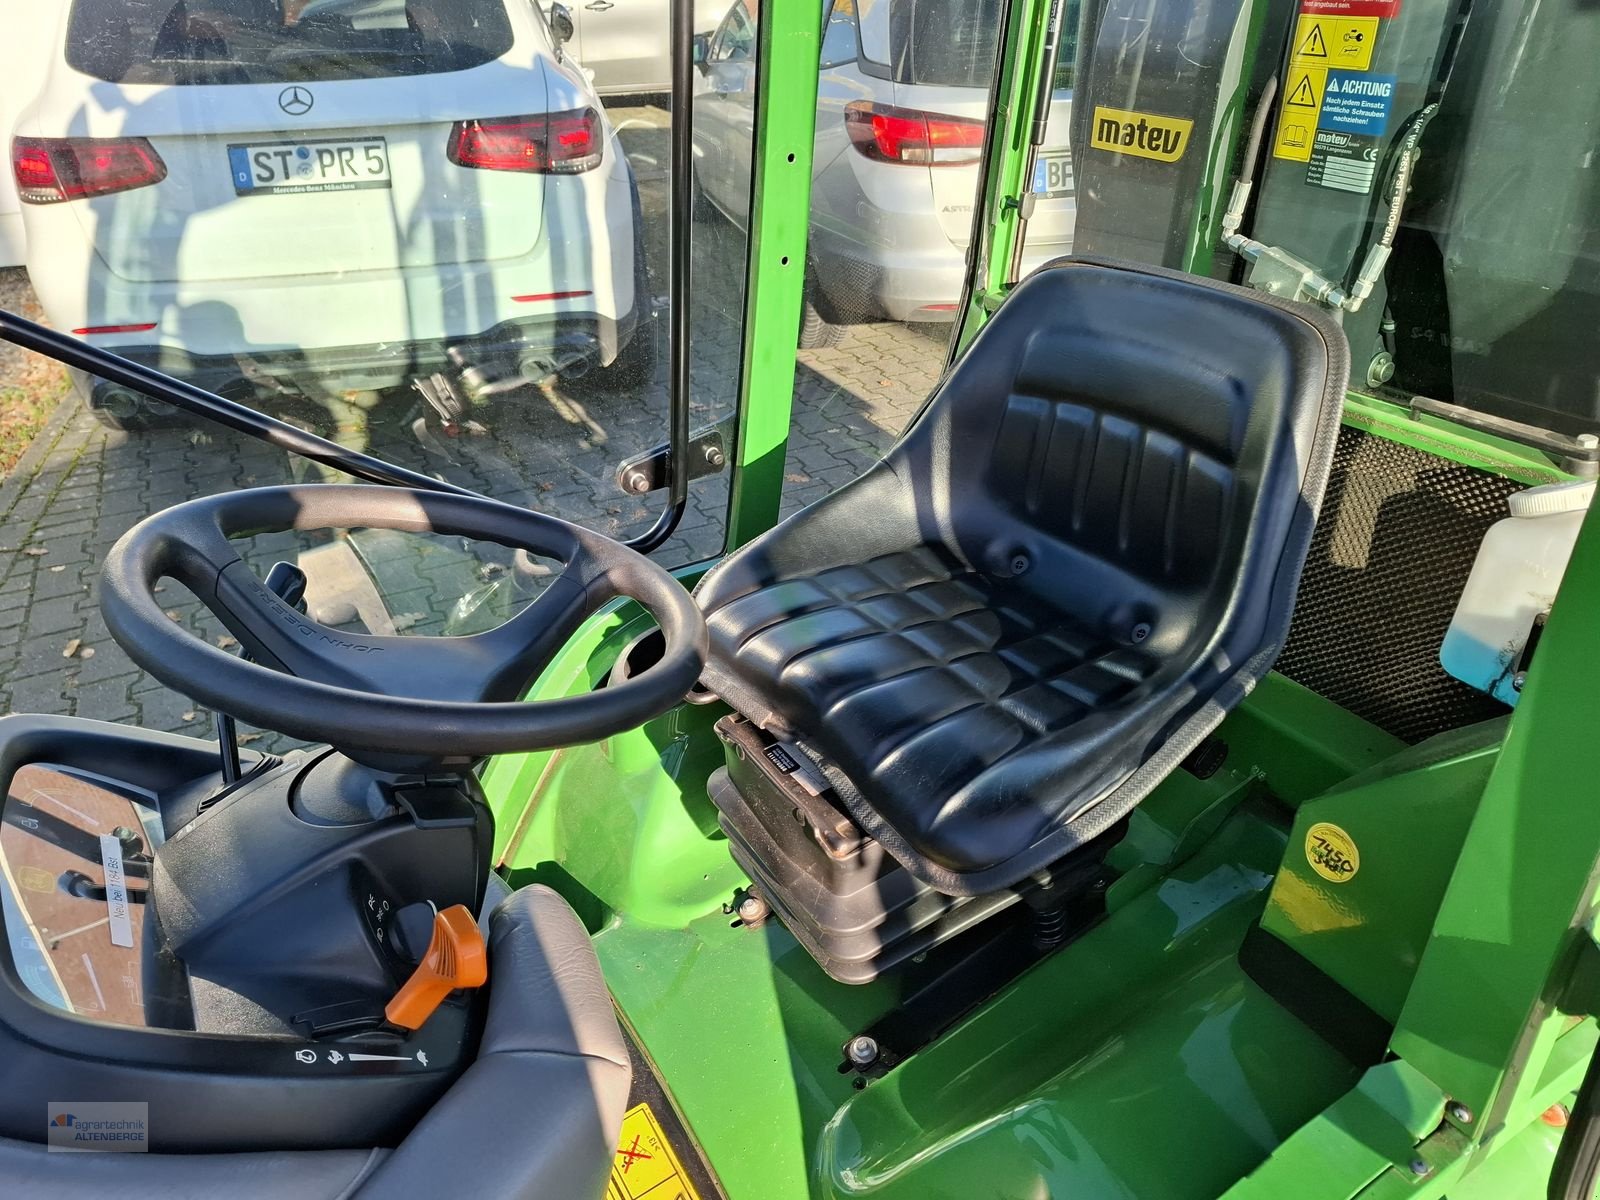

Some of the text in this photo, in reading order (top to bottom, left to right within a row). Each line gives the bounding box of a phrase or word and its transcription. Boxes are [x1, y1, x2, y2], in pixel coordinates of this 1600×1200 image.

[1341, 79, 1392, 97] ACHTUNG
[1325, 96, 1385, 109] Nach jedem Einsatz
[1322, 105, 1385, 118] sämtliche Schrauben
[1332, 115, 1369, 125] nachziehen!
[1097, 118, 1182, 155] matev
[1317, 133, 1348, 146] matev
[1406, 133, 1417, 149] WP
[1363, 148, 1379, 161] CE
[1399, 150, 1411, 172] 3263
[253, 145, 384, 183] ST PR 5
[238, 172, 247, 182] D
[1398, 172, 1406, 190] PSI
[1381, 196, 1401, 245] EUROPEAN
[247, 581, 385, 656] JOHN DEERE
[113, 903, 125, 919] Neu
